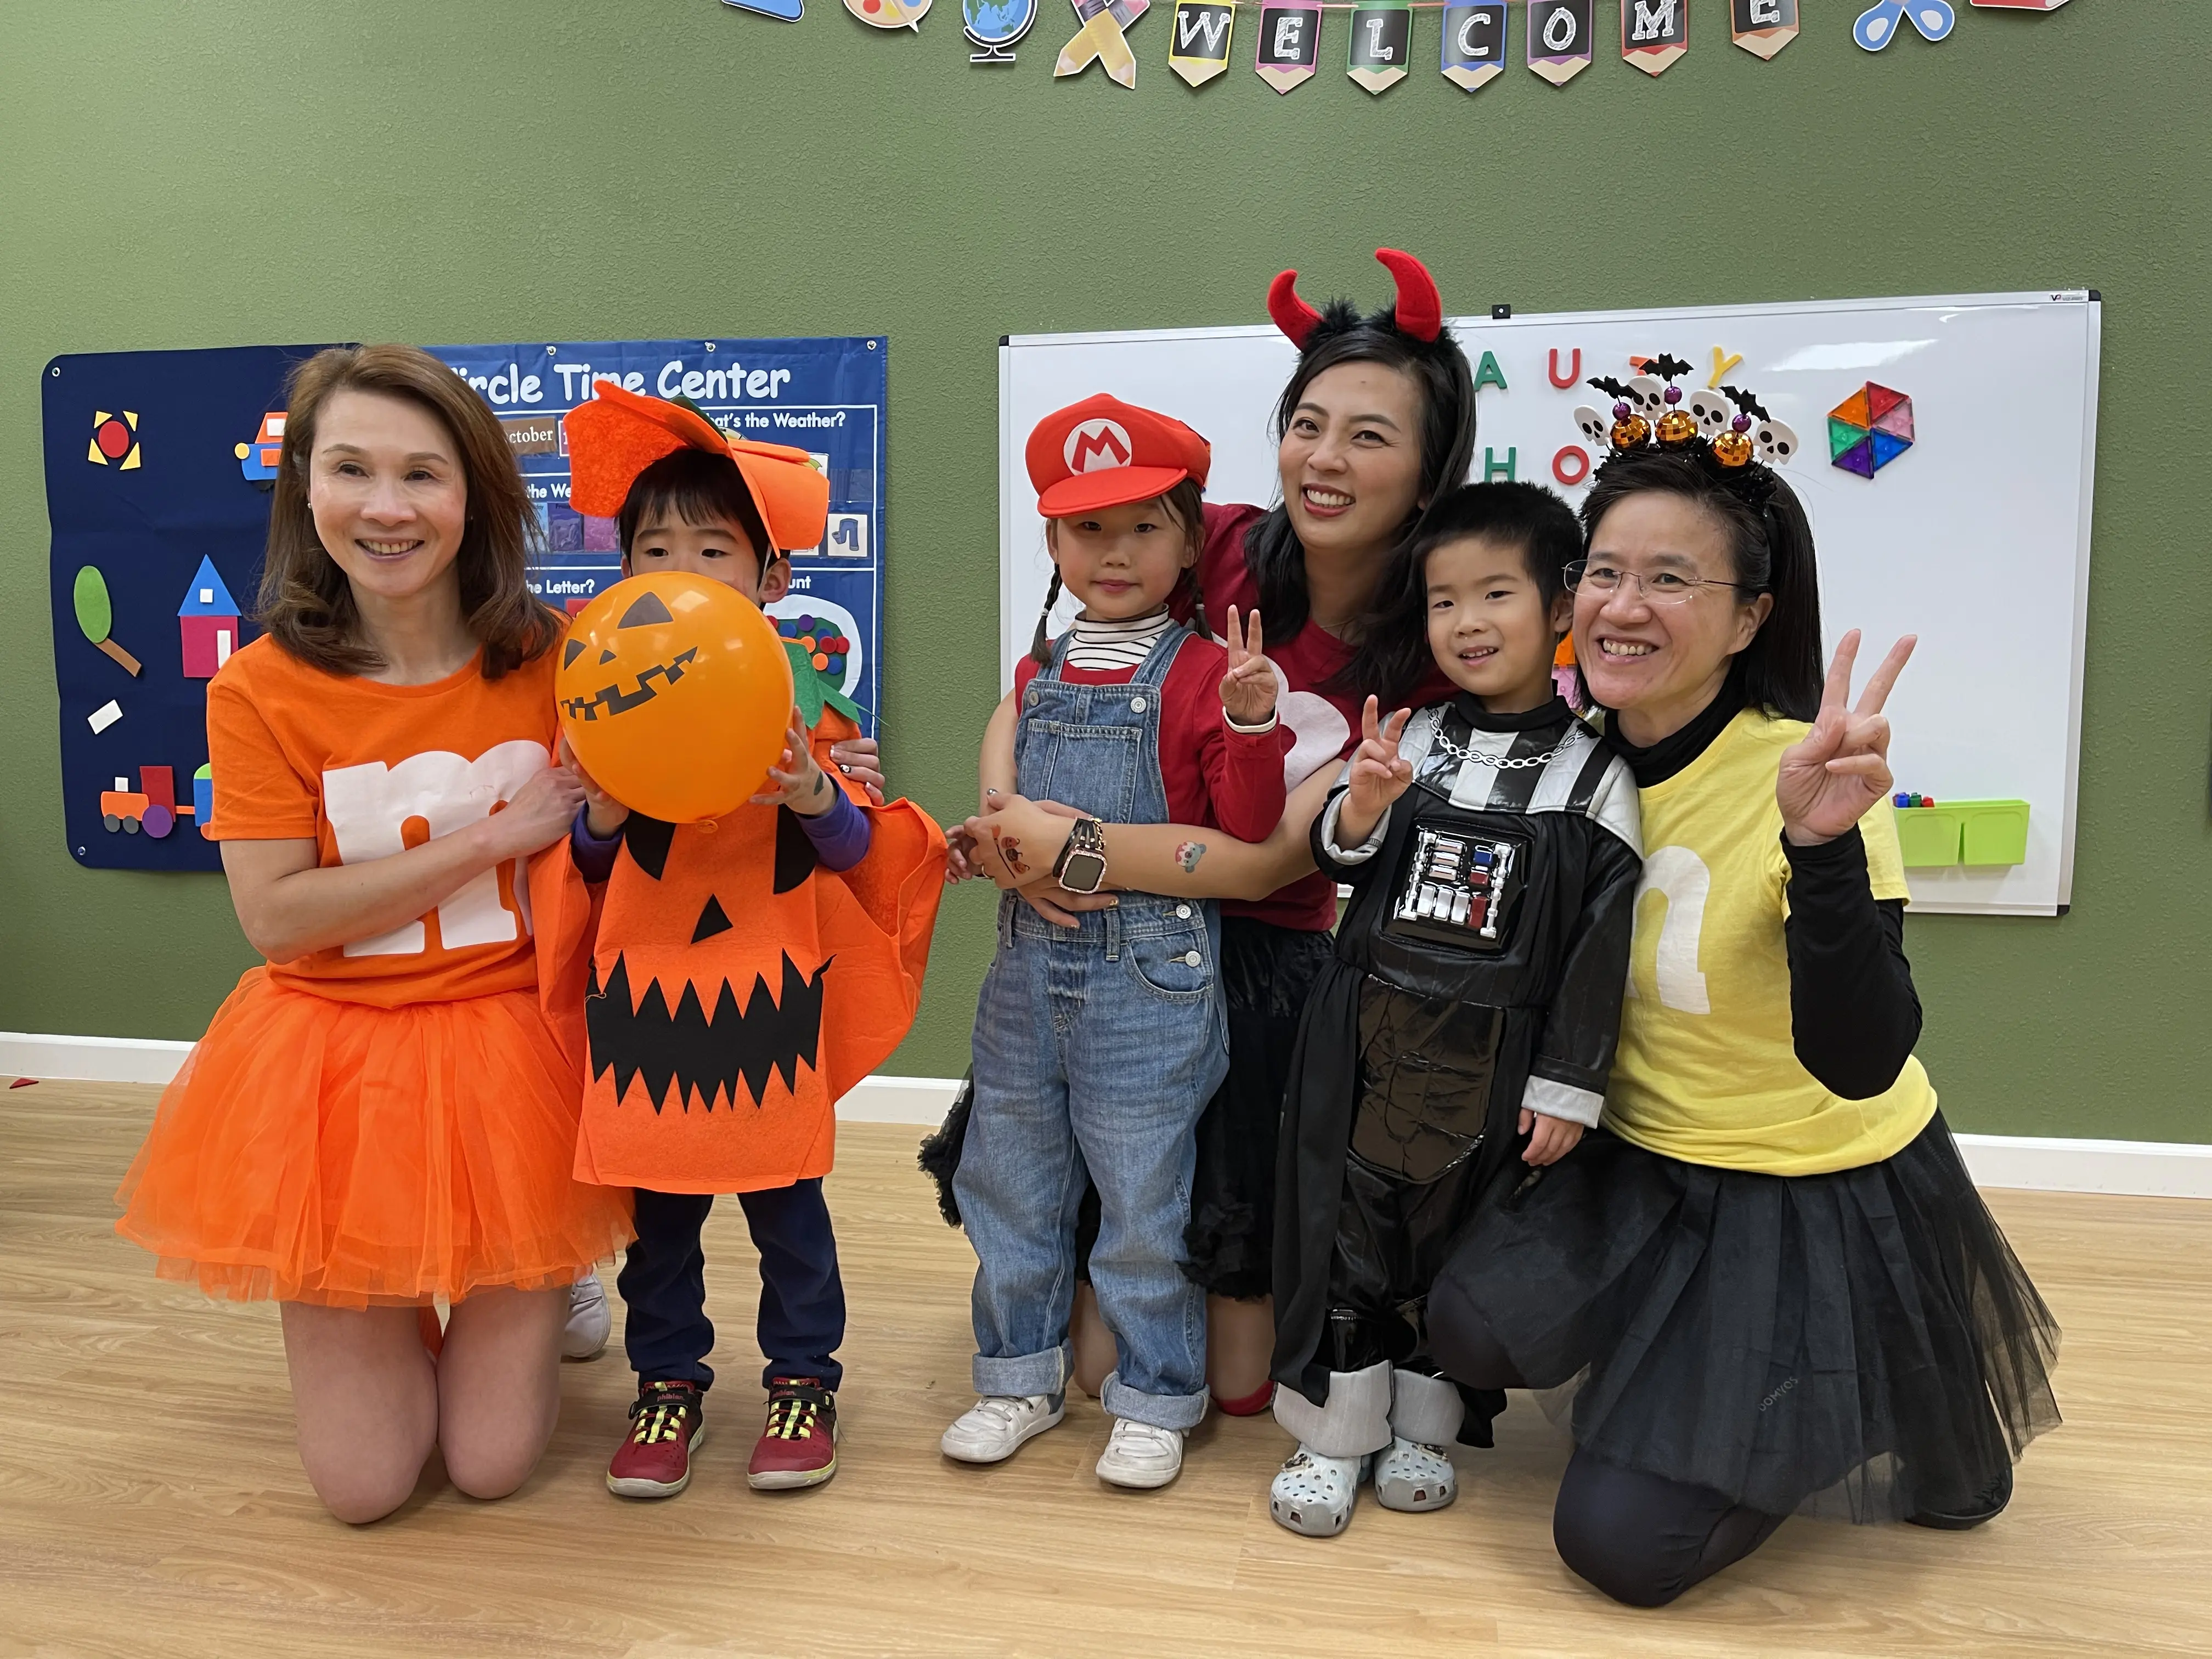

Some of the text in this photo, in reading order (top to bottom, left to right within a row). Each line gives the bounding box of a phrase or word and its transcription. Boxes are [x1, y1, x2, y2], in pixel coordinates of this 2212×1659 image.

[1178, 0, 1780, 61] WELCOME
[451, 363, 544, 405] rcle
[657, 359, 791, 399] Center
[706, 410, 846, 428] at's the Weather?
[509, 426, 554, 444] ctober
[1071, 425, 1130, 473] M
[550, 483, 571, 499] We
[526, 578, 595, 594] he Letter?
[788, 575, 811, 589] unt
